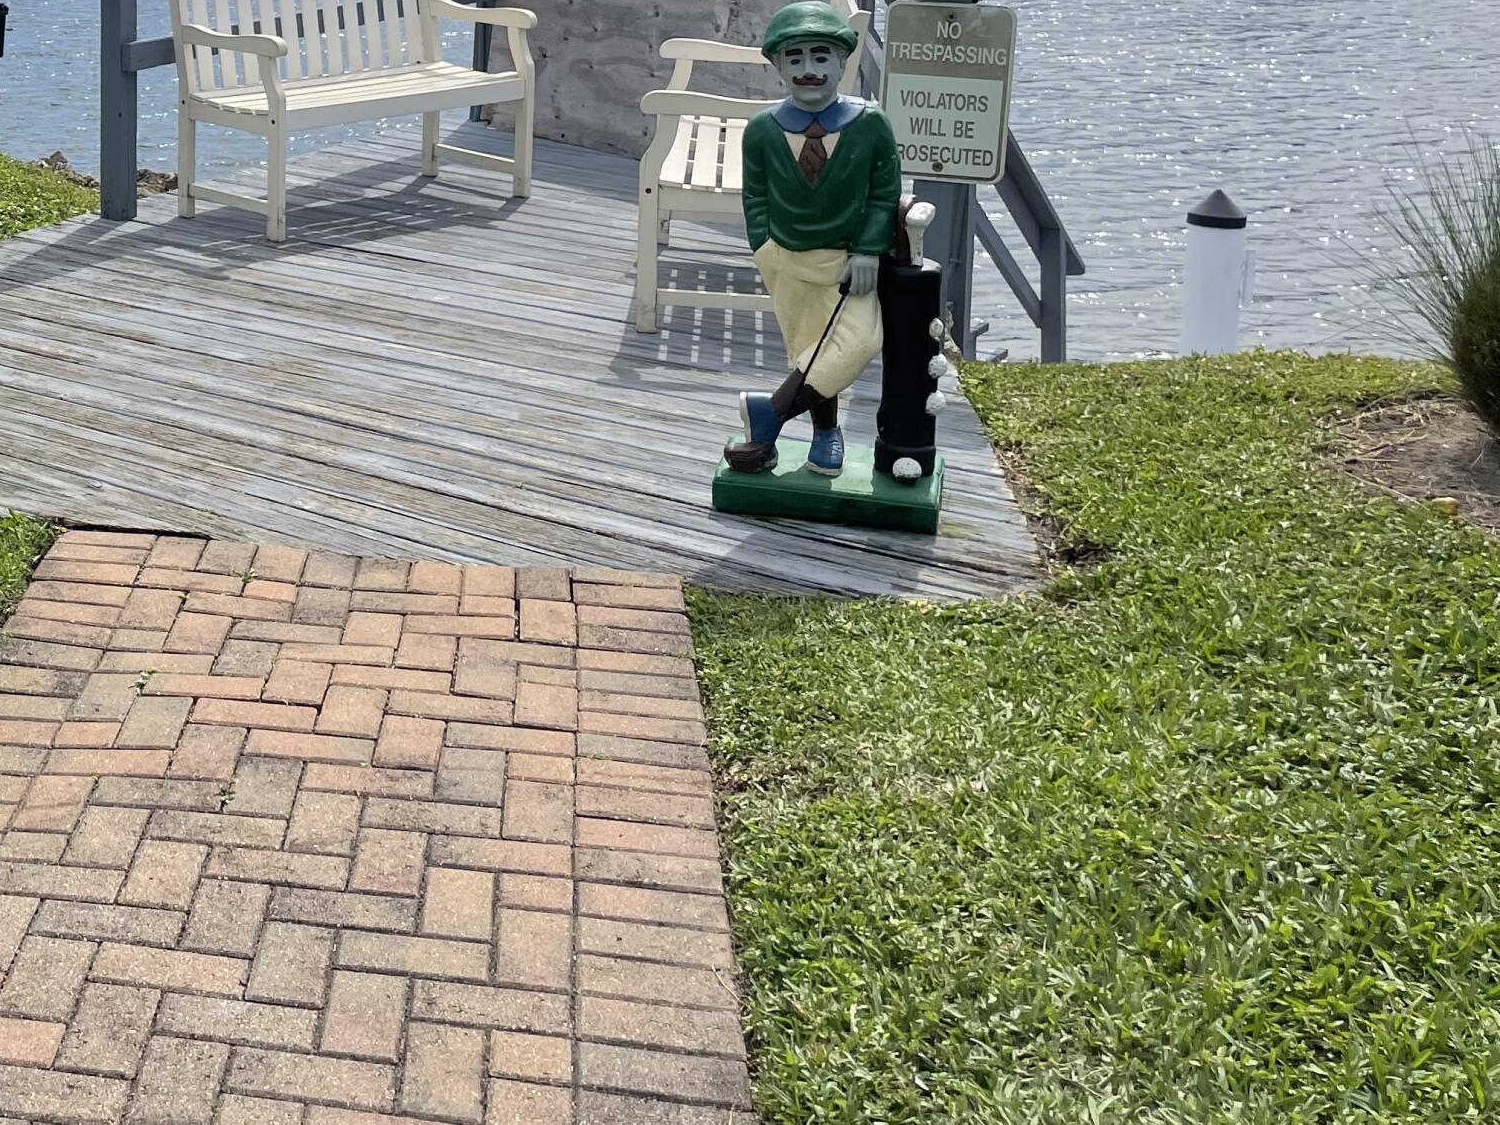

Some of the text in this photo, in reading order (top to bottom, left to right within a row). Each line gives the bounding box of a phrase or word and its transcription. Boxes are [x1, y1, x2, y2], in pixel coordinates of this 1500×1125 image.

[936, 21, 962, 39] NO
[890, 42, 1007, 65] TRESPASSING
[900, 90, 989, 112] VIOLATORS
[910, 117, 975, 139] WILL BE
[897, 144, 993, 166] ROSECUTED
